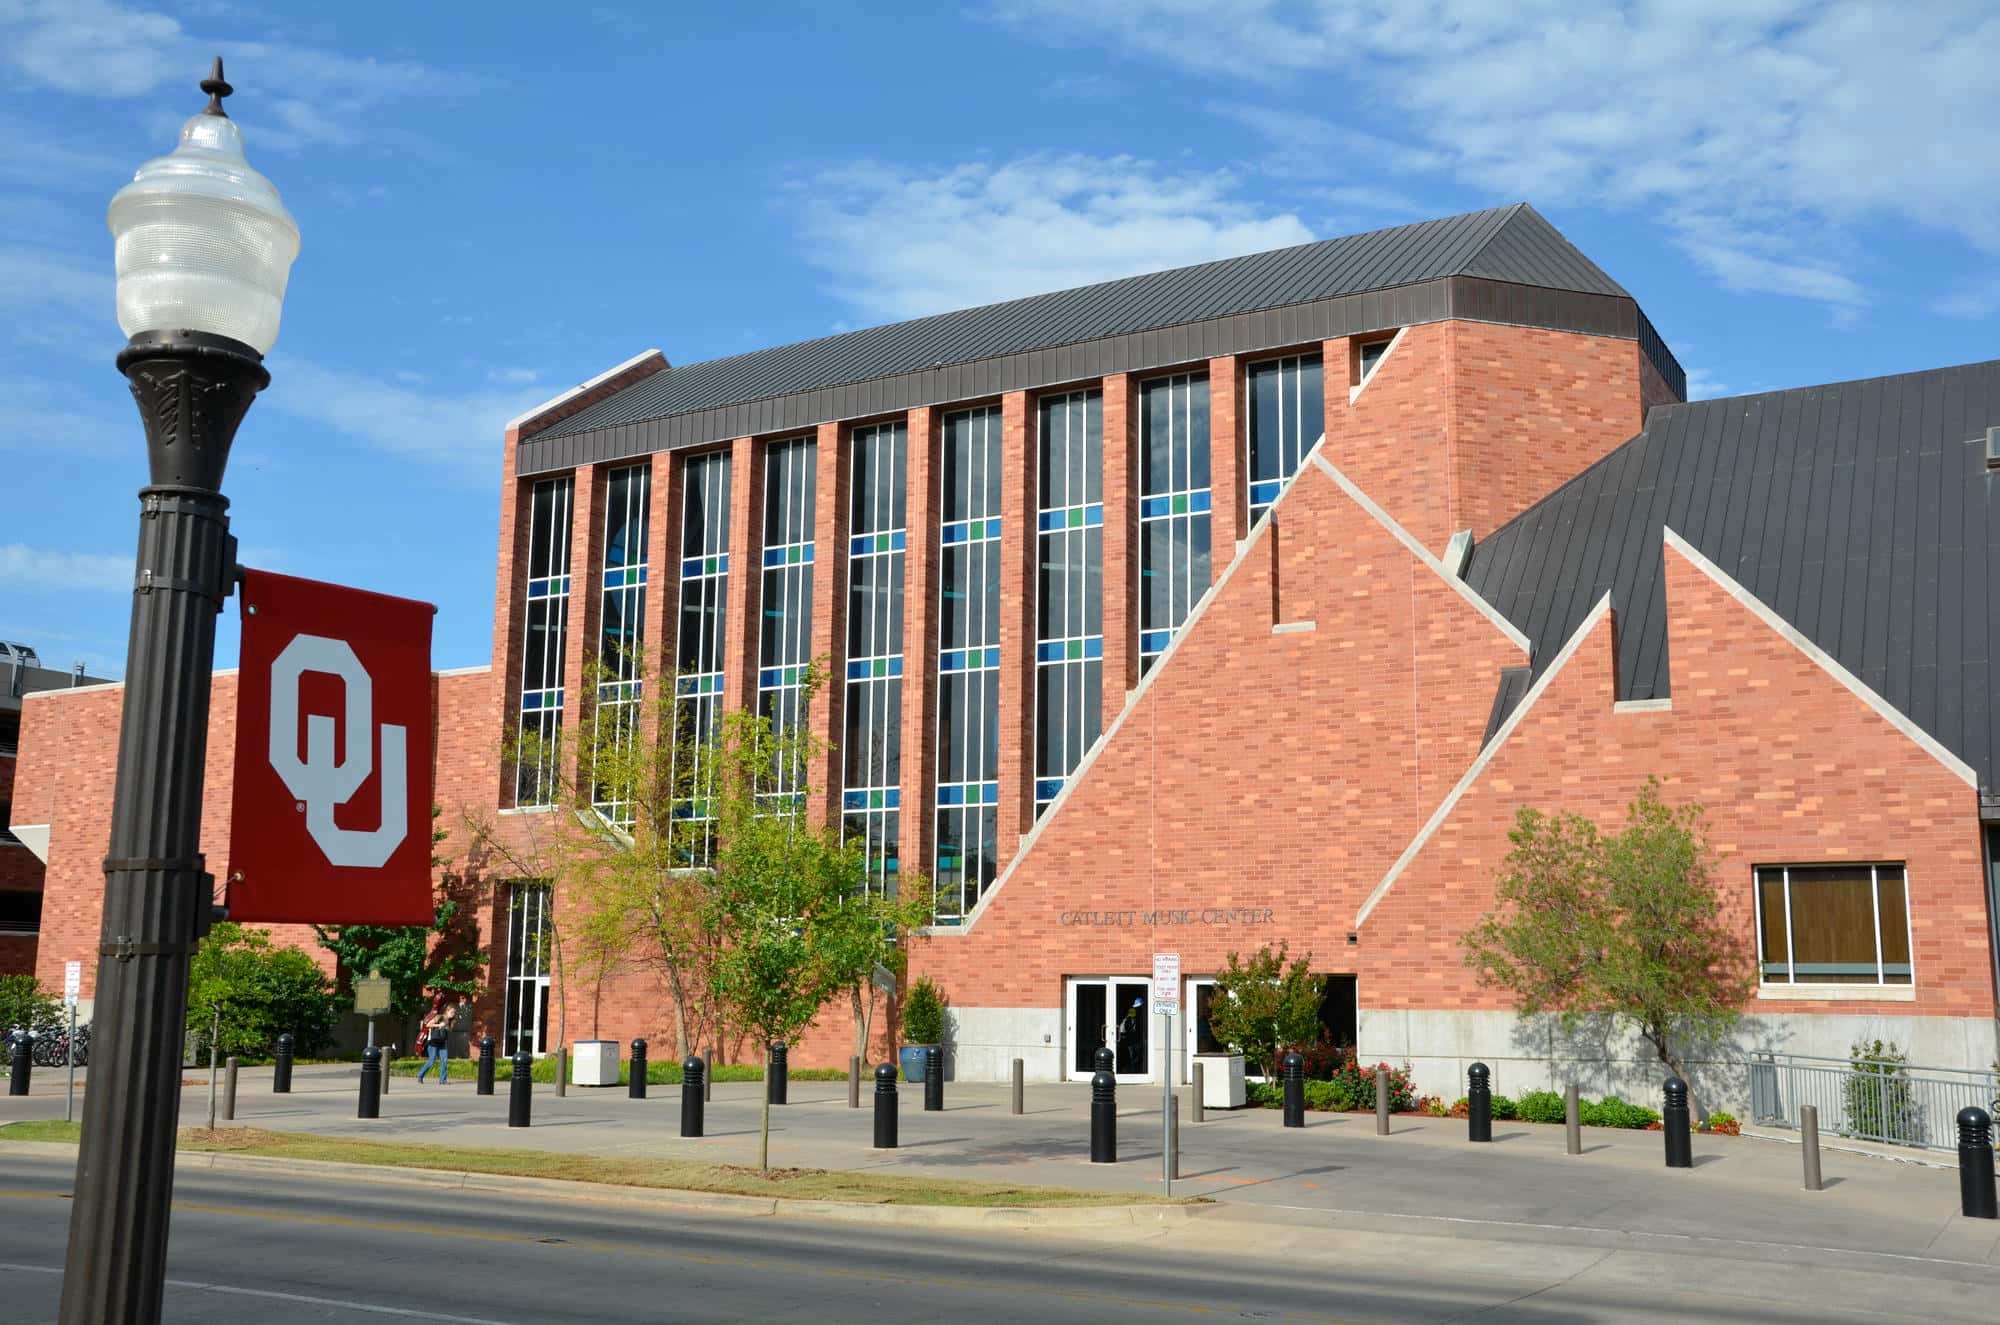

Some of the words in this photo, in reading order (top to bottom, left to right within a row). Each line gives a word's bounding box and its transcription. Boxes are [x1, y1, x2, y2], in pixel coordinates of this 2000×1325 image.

[1060, 911, 1136, 926] CATLETT
[1143, 910, 1195, 925] MUSIC
[1201, 908, 1276, 924] CENTER
